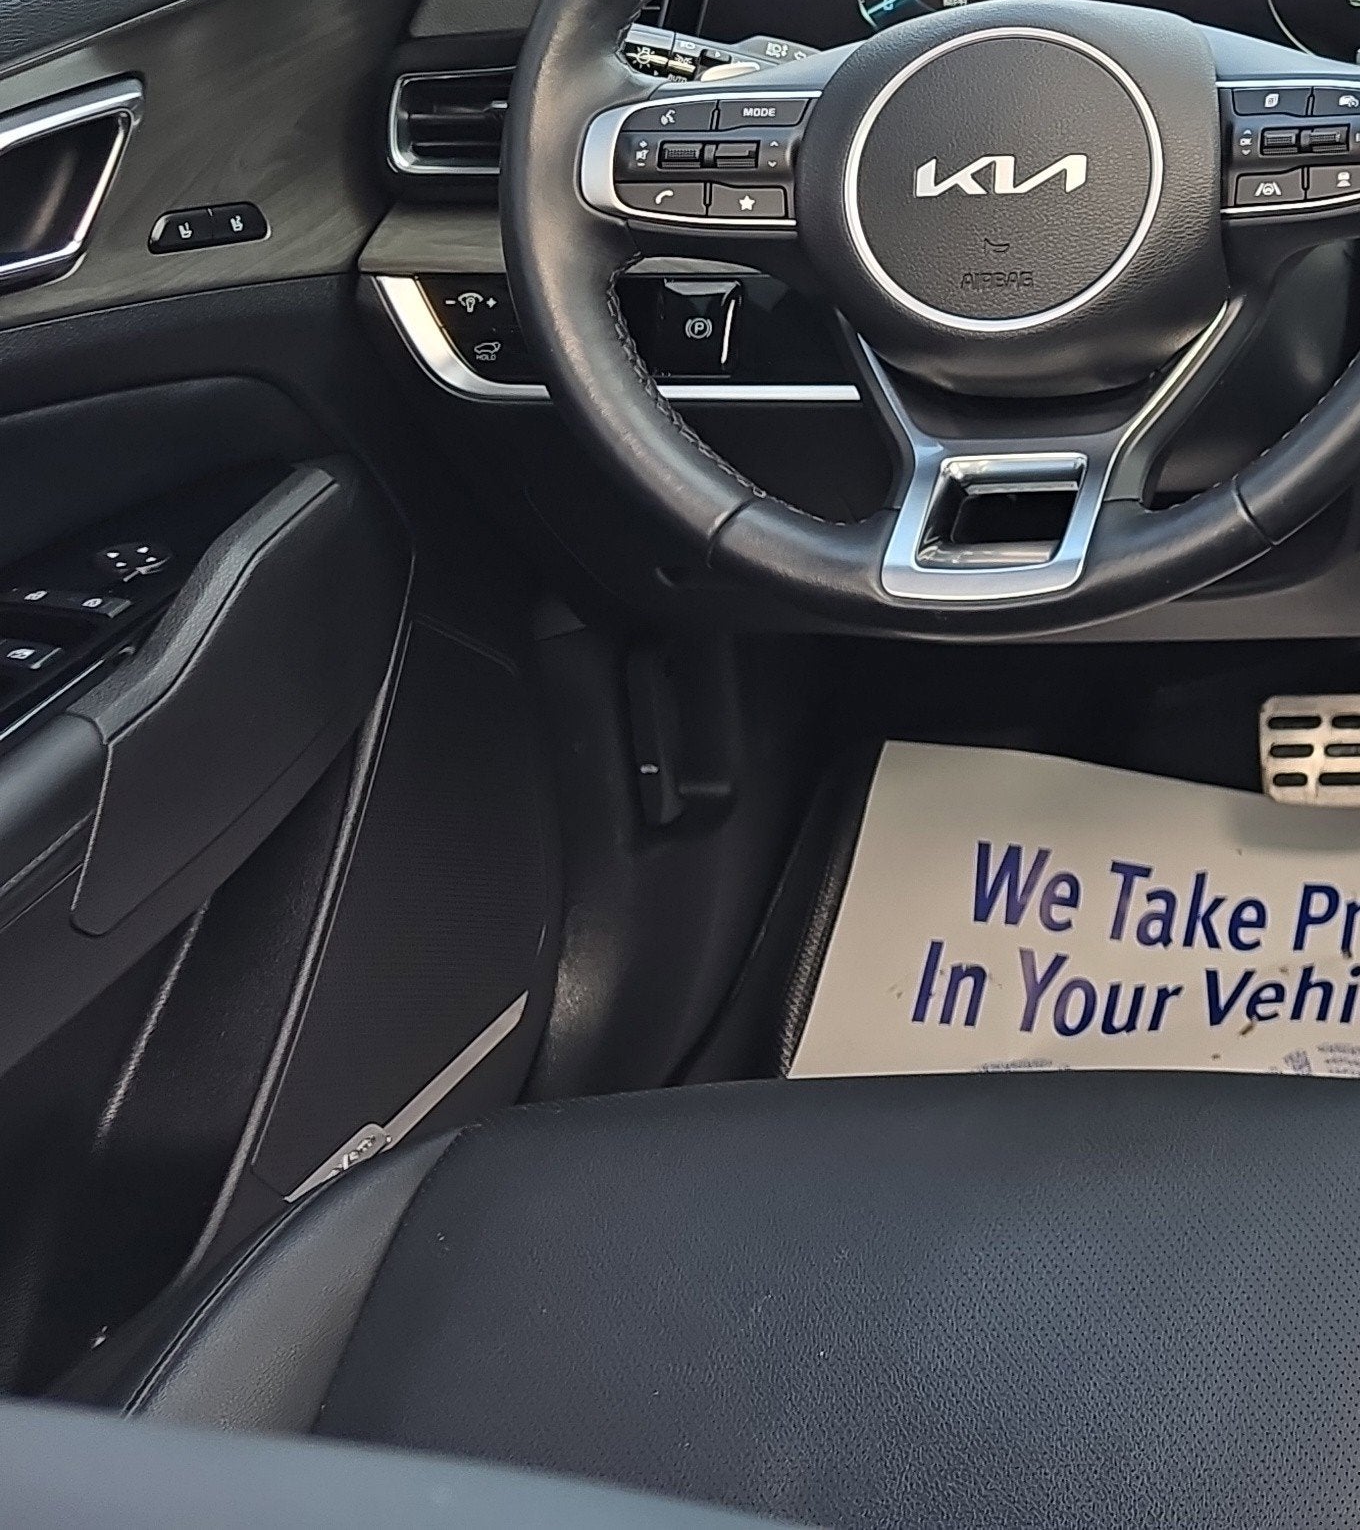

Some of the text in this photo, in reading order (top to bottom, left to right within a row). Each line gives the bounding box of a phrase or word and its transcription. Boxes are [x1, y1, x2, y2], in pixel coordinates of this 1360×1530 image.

[667, 73, 688, 84] AUTO
[743, 107, 776, 118] MODE
[960, 272, 1034, 289] AIRBAG
[972, 841, 1082, 932] We
[1109, 860, 1267, 951] Take
[911, 940, 988, 1026] In
[1017, 947, 1184, 1037] Your
